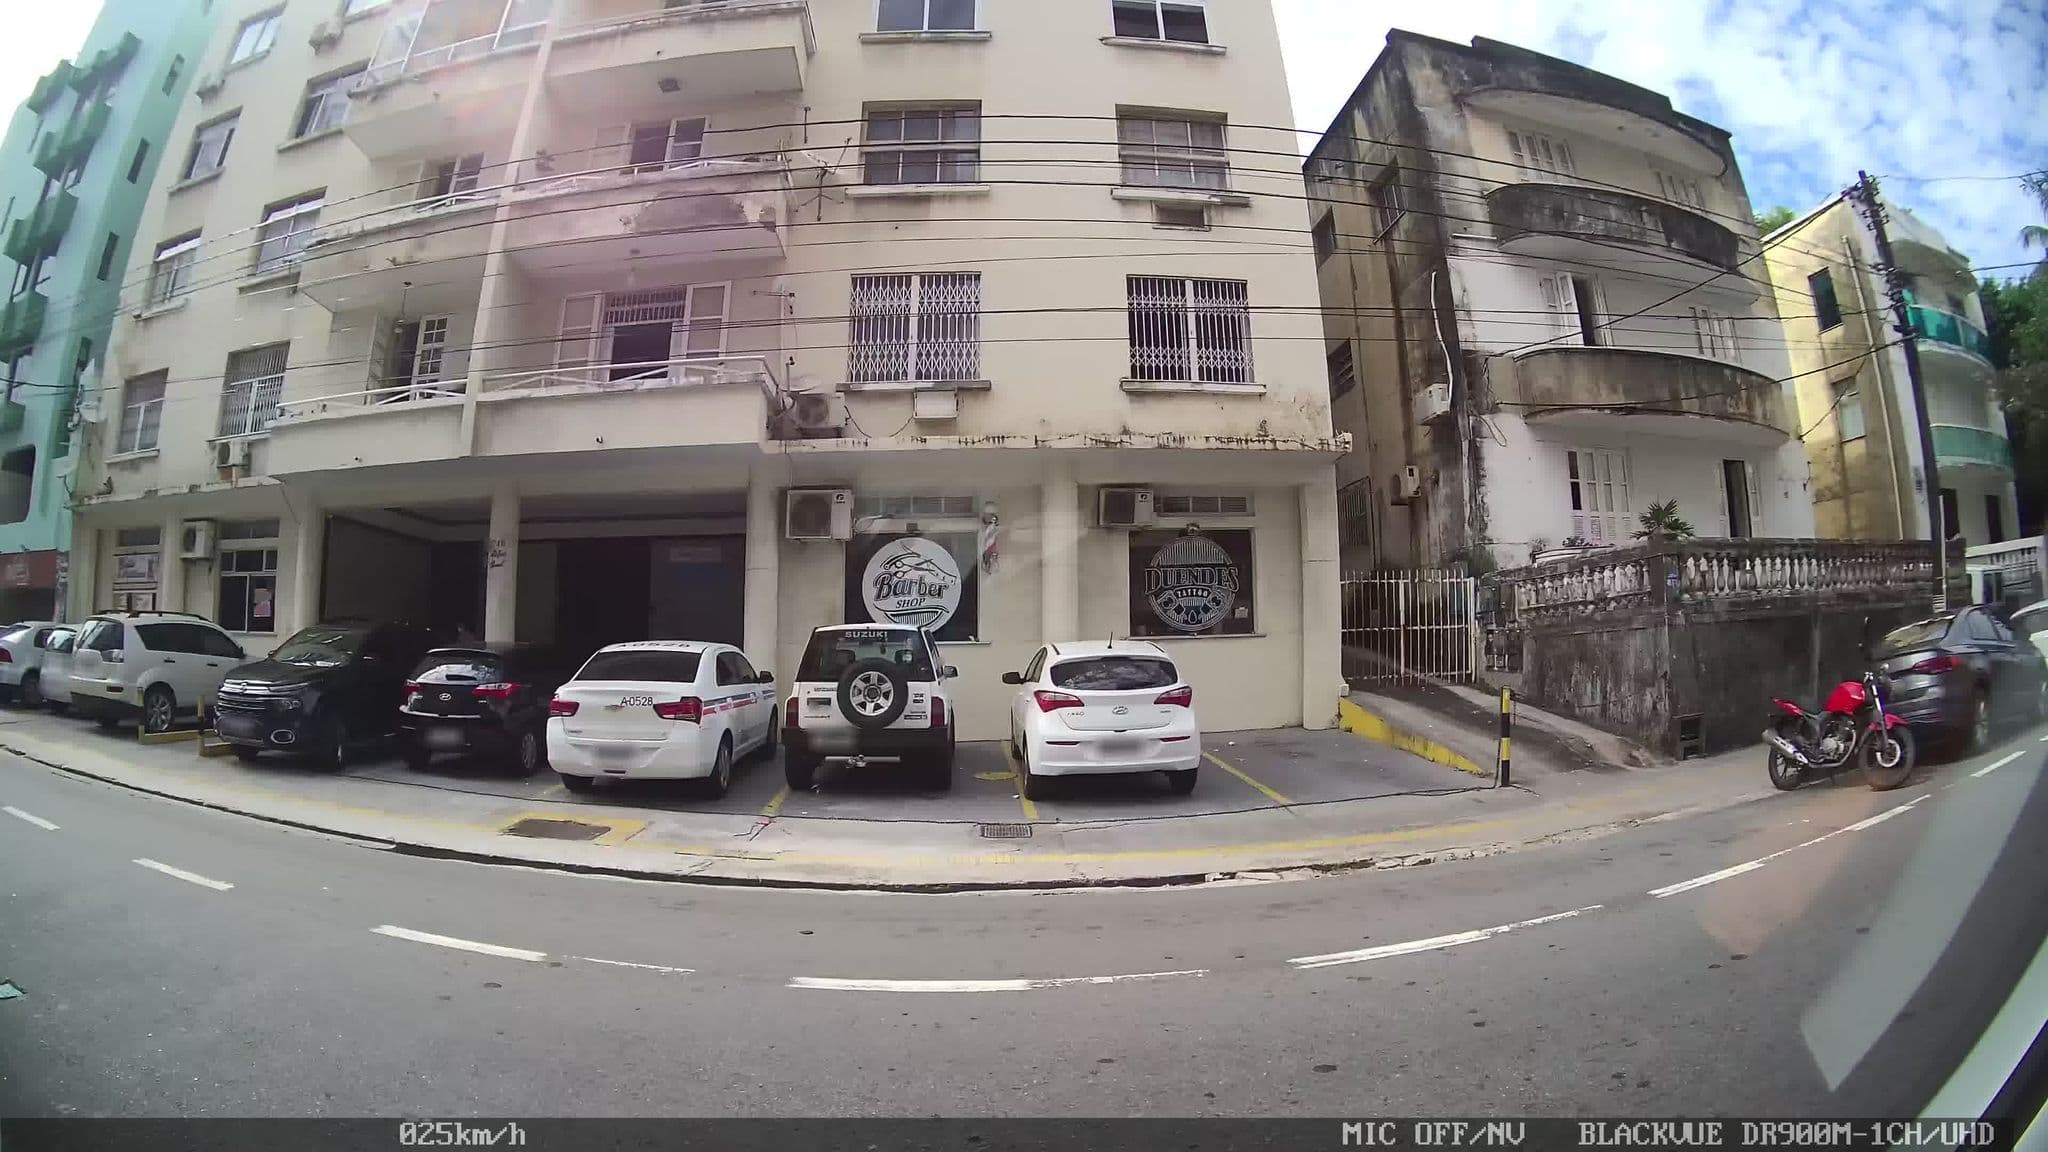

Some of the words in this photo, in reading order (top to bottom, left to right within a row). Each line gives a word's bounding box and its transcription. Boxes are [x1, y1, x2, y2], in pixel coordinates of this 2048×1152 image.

[873, 571, 949, 601] Barber
[1145, 567, 1240, 595] DUENDES
[896, 597, 926, 609] SHOP
[620, 696, 654, 706] A-0528
